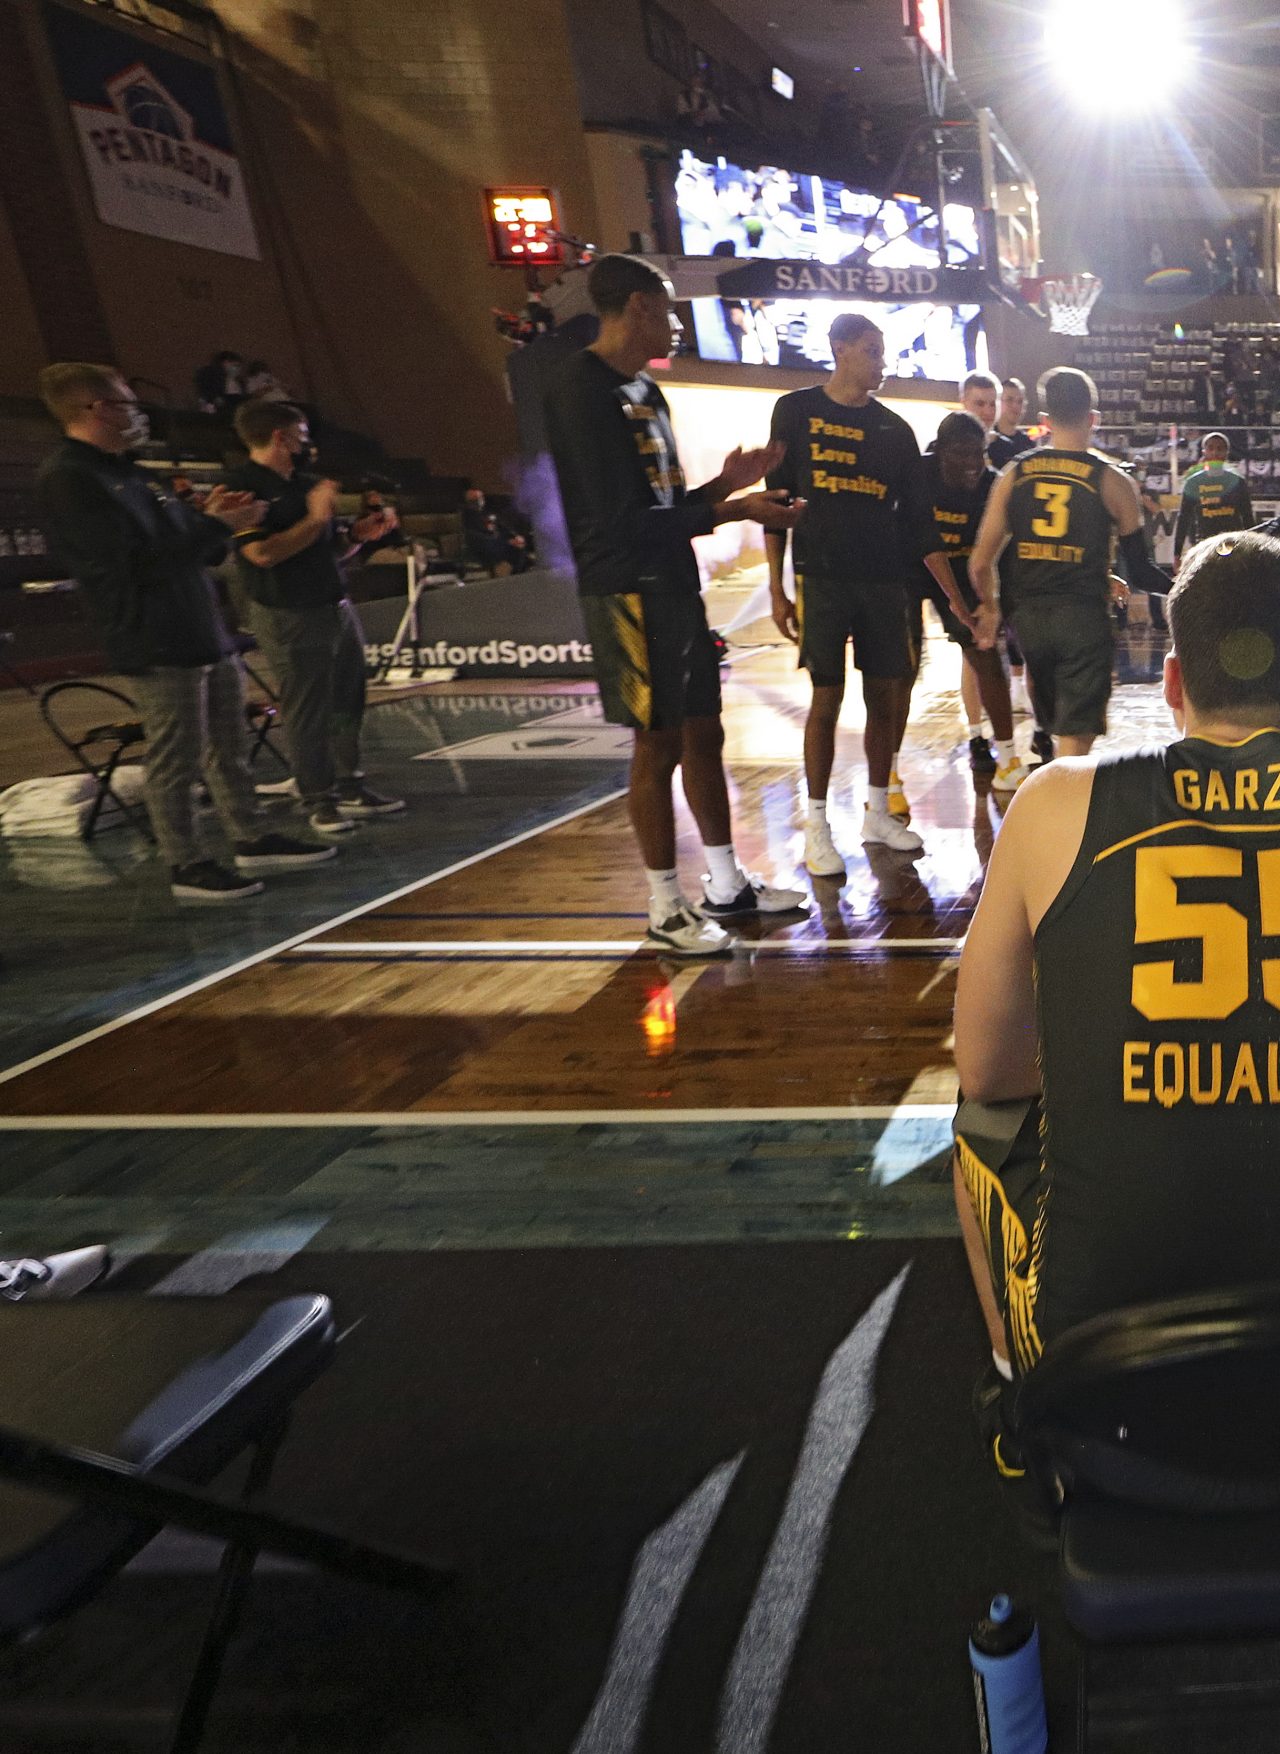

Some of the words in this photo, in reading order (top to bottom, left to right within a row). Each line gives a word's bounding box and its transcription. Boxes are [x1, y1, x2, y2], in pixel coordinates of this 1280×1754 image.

[90, 128, 231, 199] PENTAGON
[775, 265, 938, 294] SANFORD
[808, 417, 865, 442] Peace
[809, 443, 857, 465] Love
[812, 469, 888, 500] Equality
[1031, 481, 1072, 538] 3
